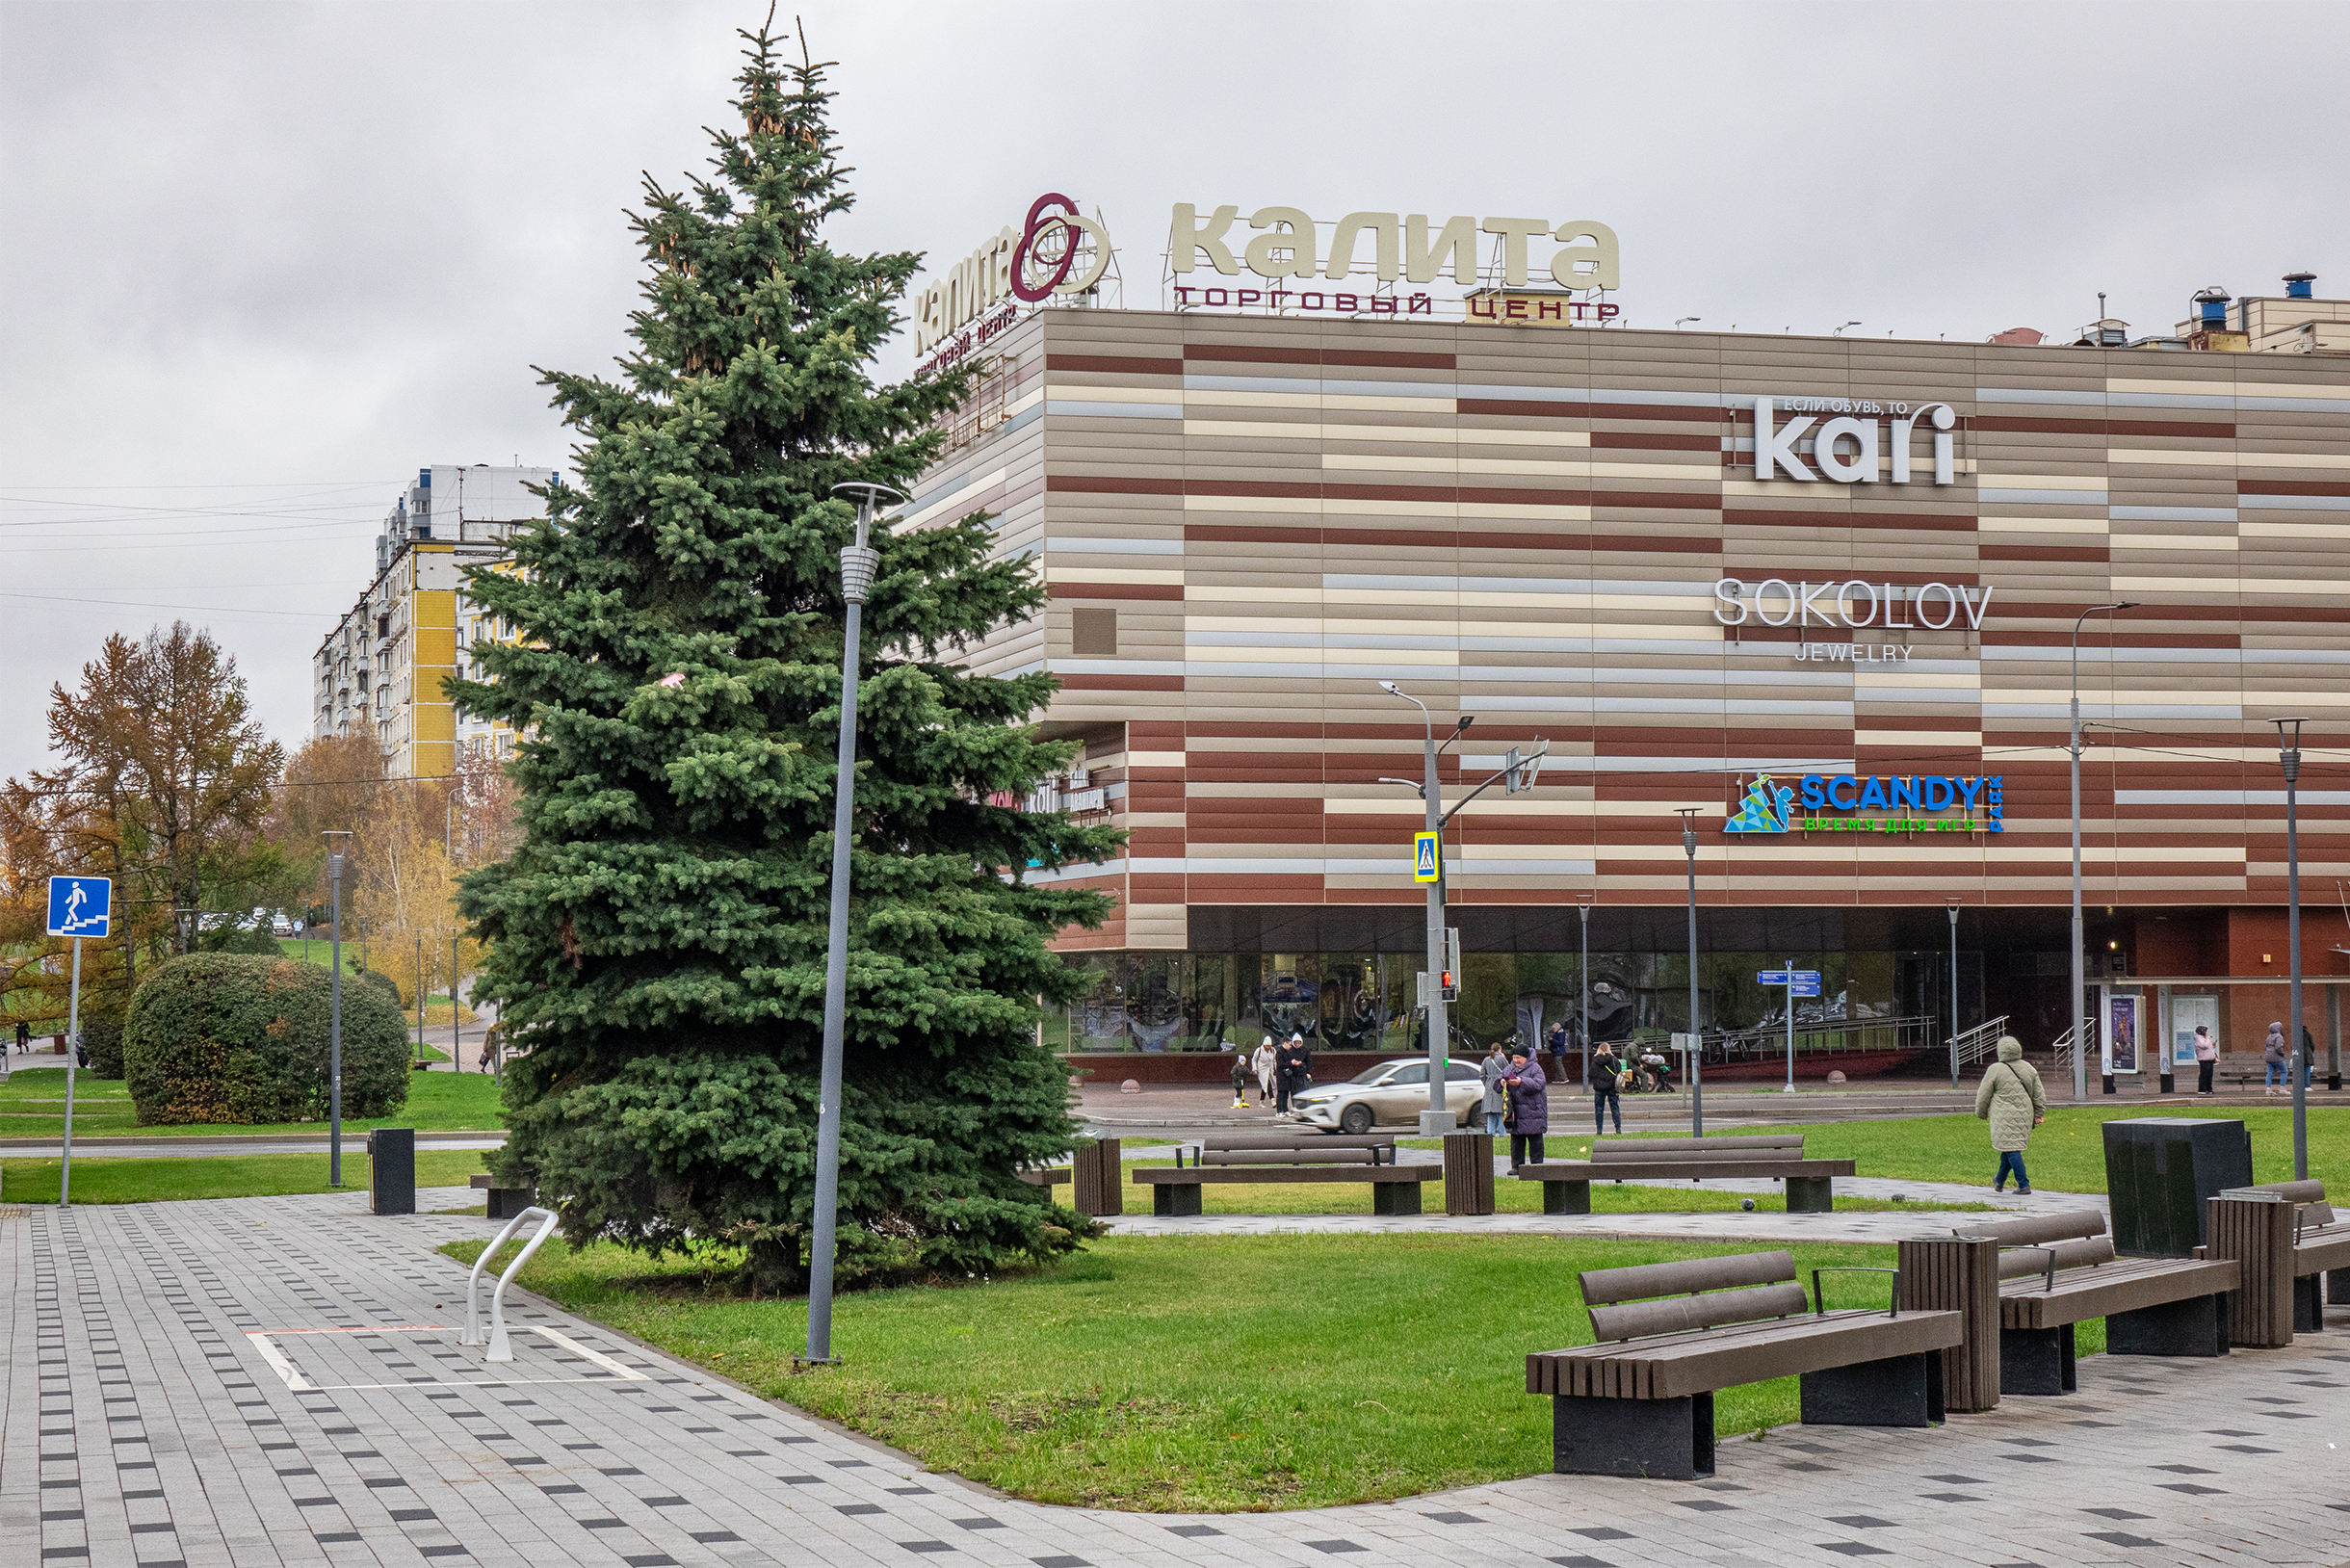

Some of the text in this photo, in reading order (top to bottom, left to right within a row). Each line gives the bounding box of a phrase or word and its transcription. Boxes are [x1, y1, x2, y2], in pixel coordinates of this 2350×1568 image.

[1174, 287, 1619, 321] ТОРГОВЫЙ ЦЕНТР
[1784, 399, 1908, 415] ЕСЛИ ОБУВЬ, ТО
[1755, 397, 1955, 484] kari
[1713, 578, 1993, 630] SOKOLOV
[1794, 643, 1914, 663] JEWELRY
[1800, 774, 1984, 810] SCANDY
[1988, 775, 2004, 832] PARK
[1805, 818, 1975, 834] ВРЕМЯ ДЛЯ ИГР
